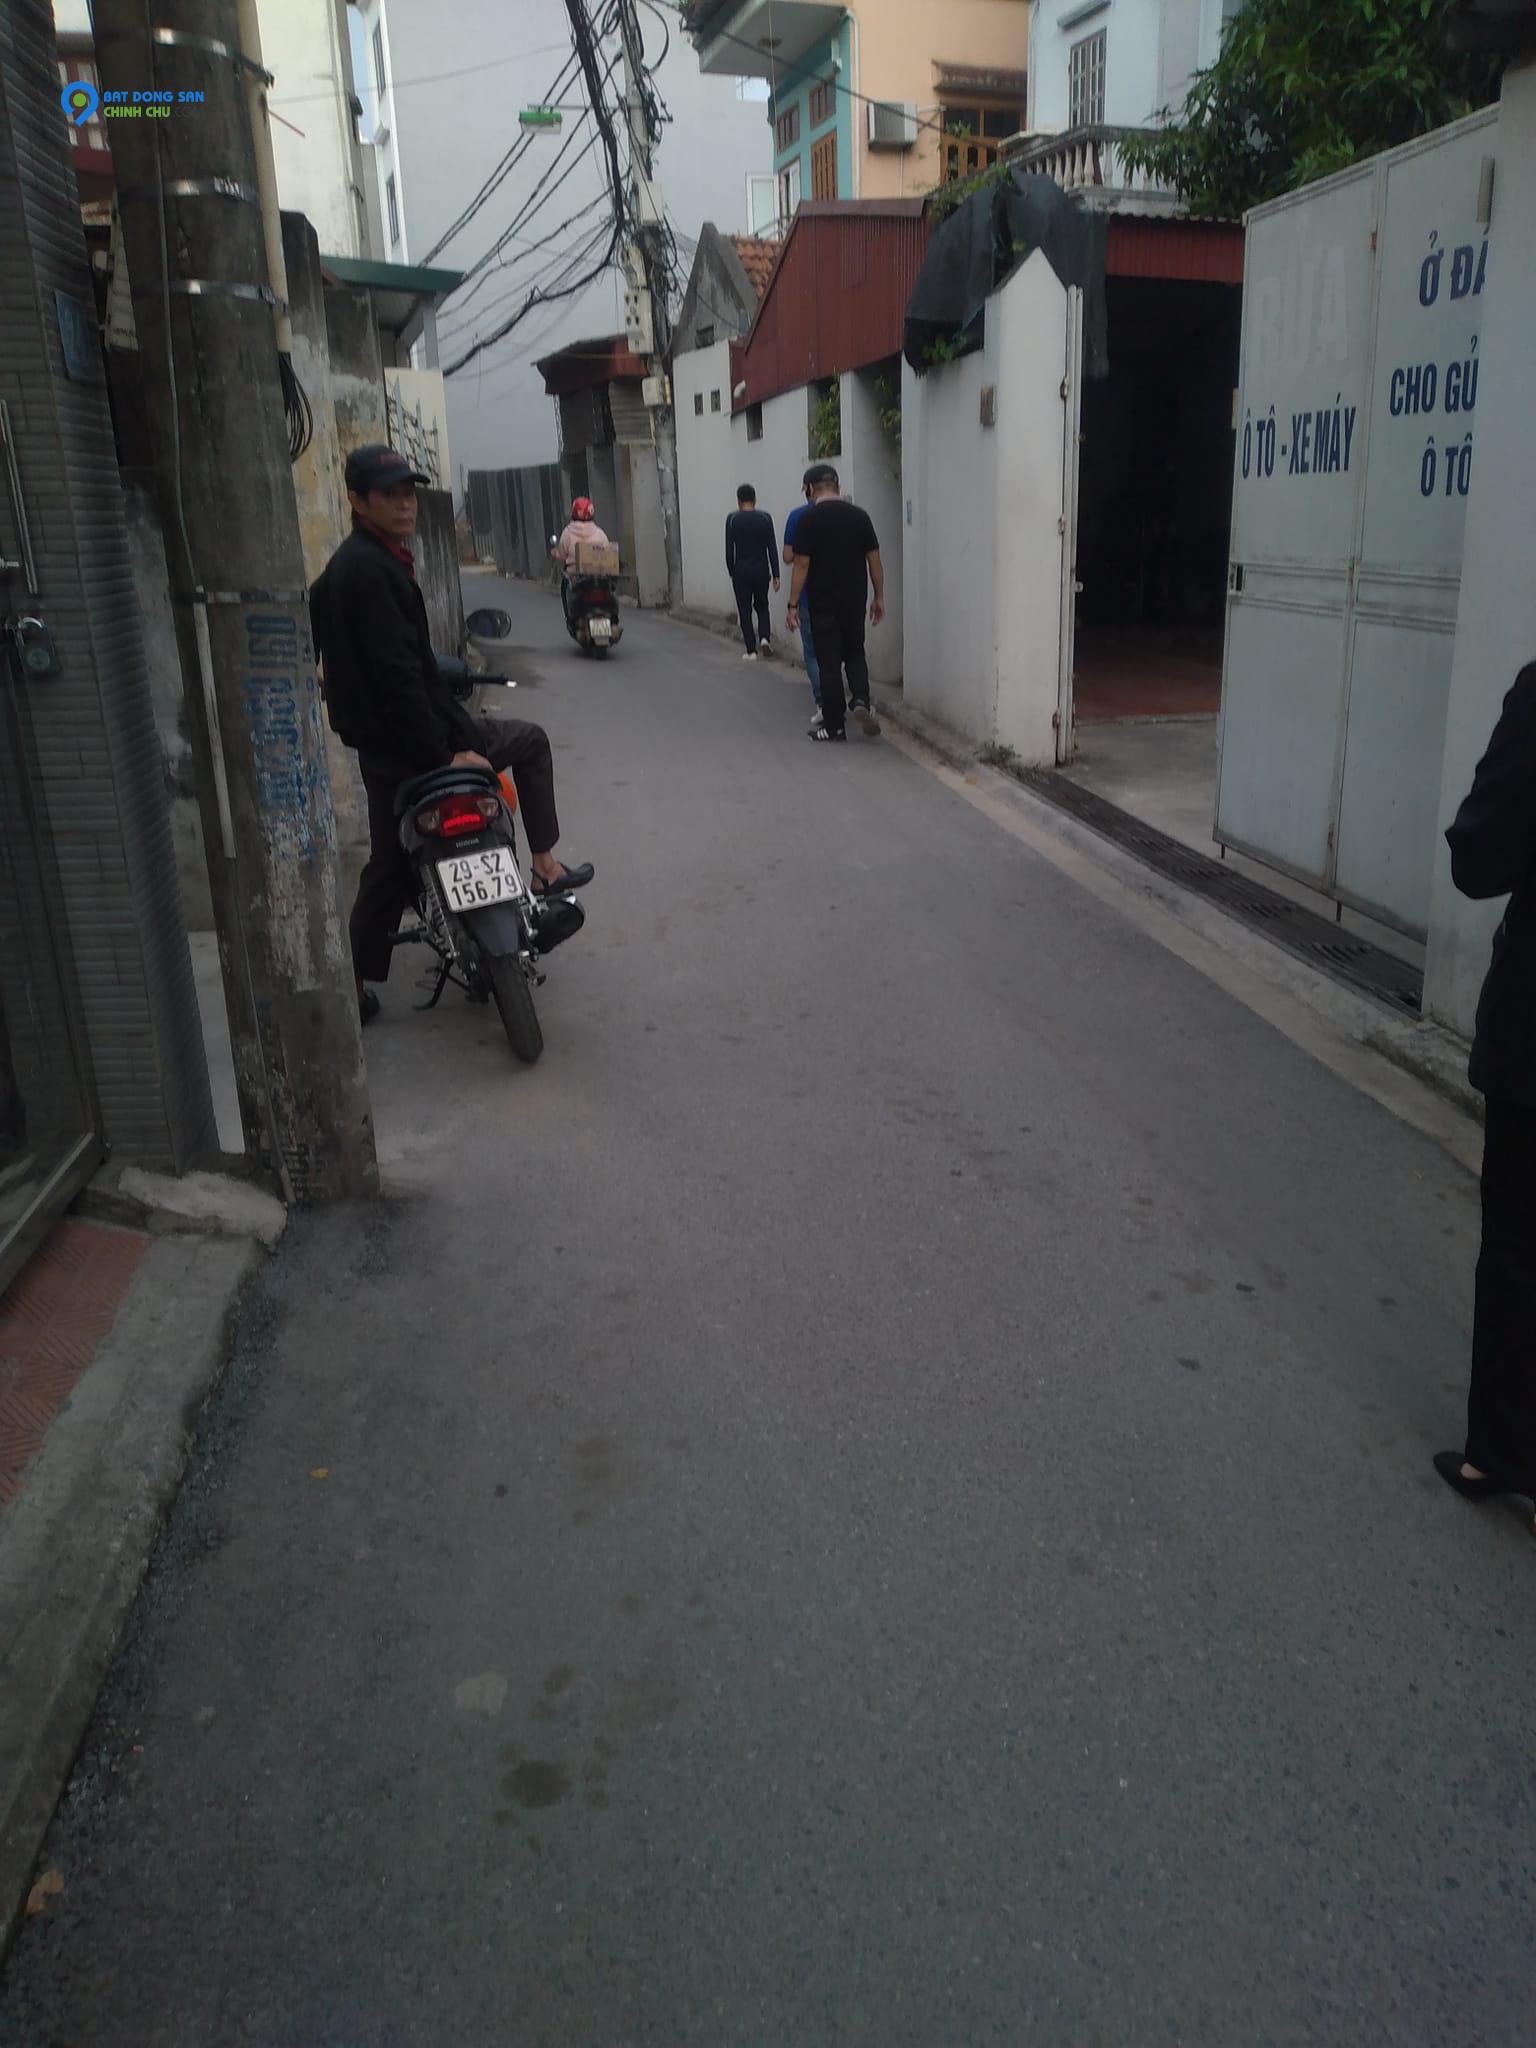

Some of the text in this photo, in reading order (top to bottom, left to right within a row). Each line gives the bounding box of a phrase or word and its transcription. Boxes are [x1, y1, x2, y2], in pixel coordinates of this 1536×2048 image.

[1418, 229, 1445, 307] Ở
[1389, 363, 1438, 417] CHO
[1242, 407, 1252, 479] Ô
[1256, 404, 1276, 478] TÔ
[1312, 392, 1356, 473] MÁY
[1420, 432, 1473, 497] Ô TÔ
[449, 853, 505, 883] 29-S2
[451, 873, 518, 907] 156.79
